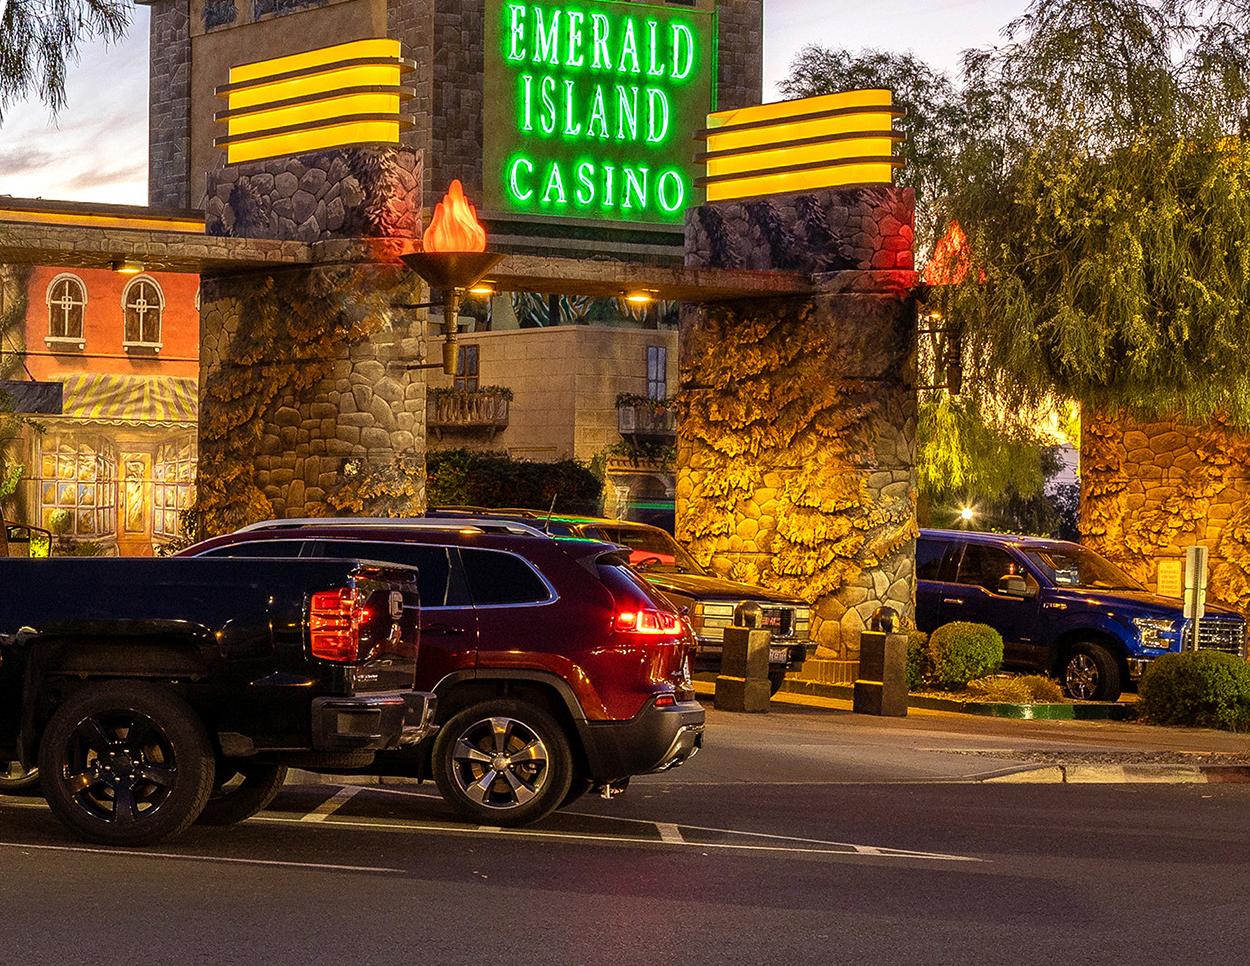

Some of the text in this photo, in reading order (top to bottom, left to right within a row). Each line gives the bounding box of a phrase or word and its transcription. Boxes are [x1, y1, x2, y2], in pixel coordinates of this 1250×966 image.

[508, 4, 694, 79] EMERALD
[523, 75, 669, 143] ISLAND
[510, 158, 684, 212] CASINO
